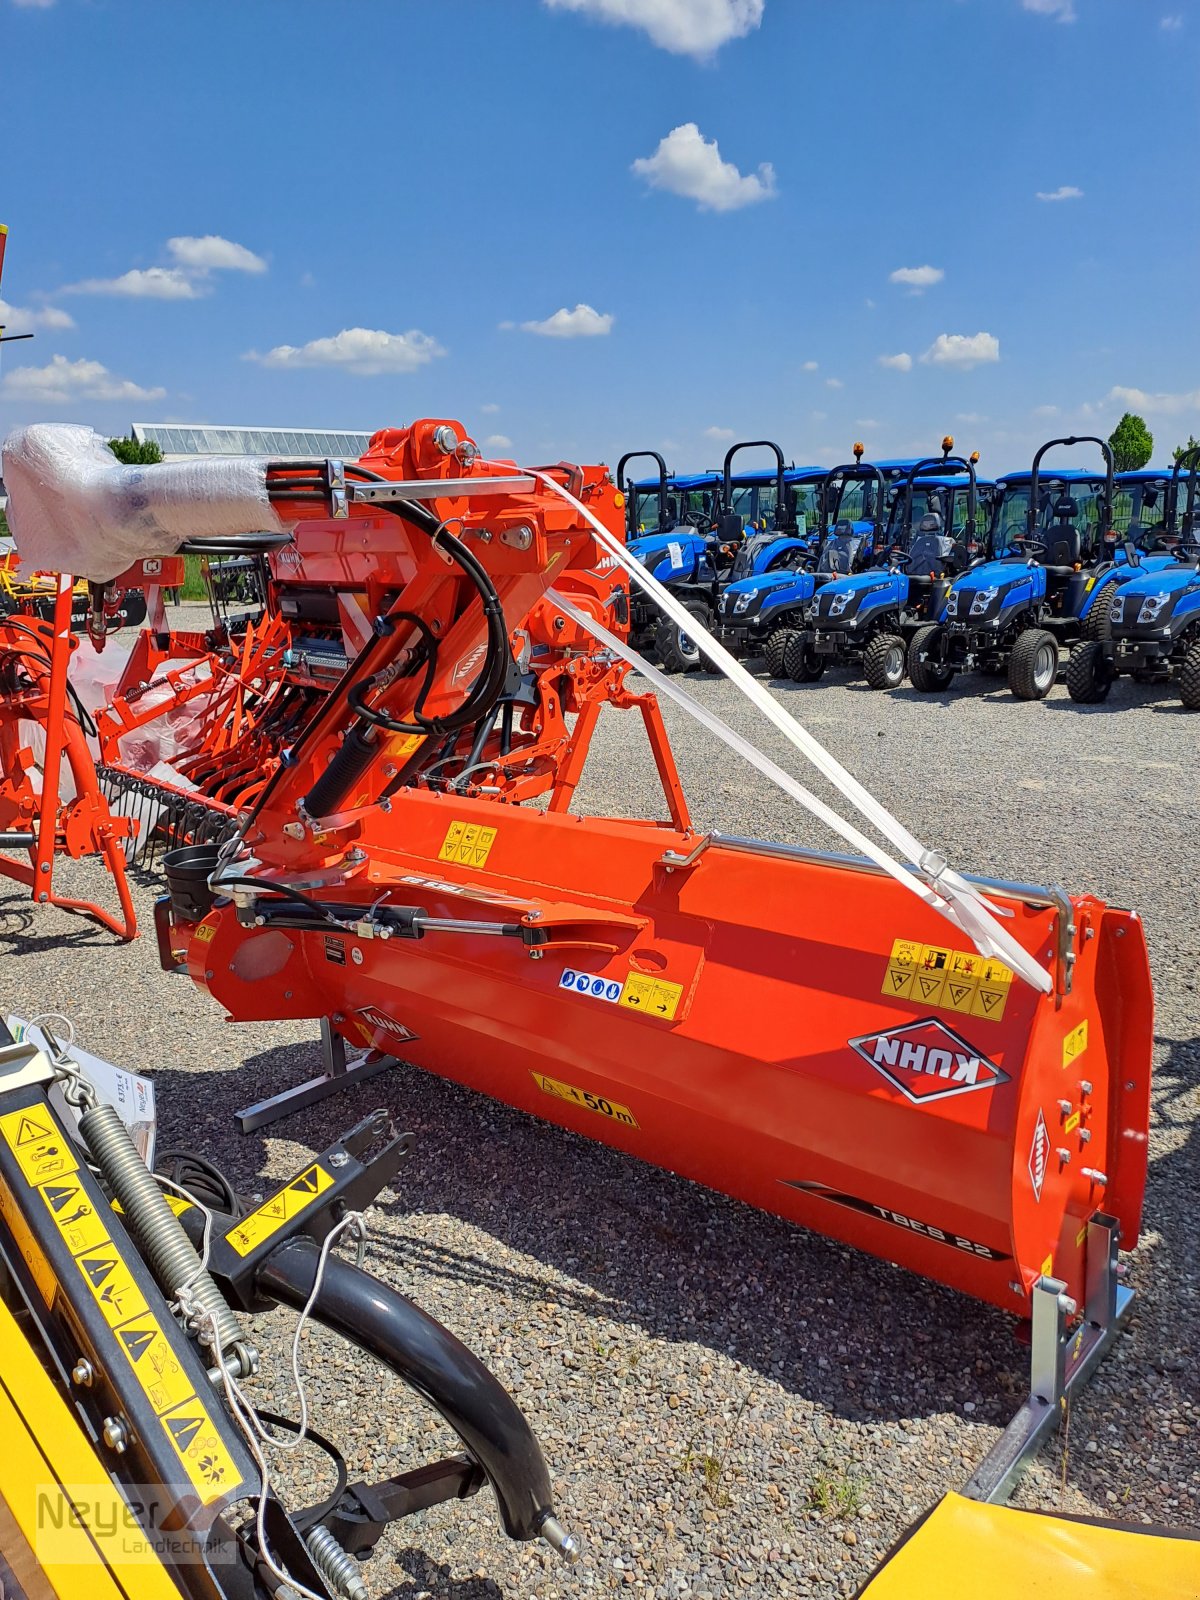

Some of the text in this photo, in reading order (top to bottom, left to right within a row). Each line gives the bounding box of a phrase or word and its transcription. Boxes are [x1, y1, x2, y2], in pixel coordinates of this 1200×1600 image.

[71, 612, 86, 623] EW
[899, 943, 916, 951] STOP
[362, 1011, 411, 1038] KUHN
[873, 1036, 981, 1085] KUHN
[583, 1091, 633, 1124] 50 m
[1033, 1124, 1045, 1188] KUHN
[873, 1205, 993, 1258] TBES 22
